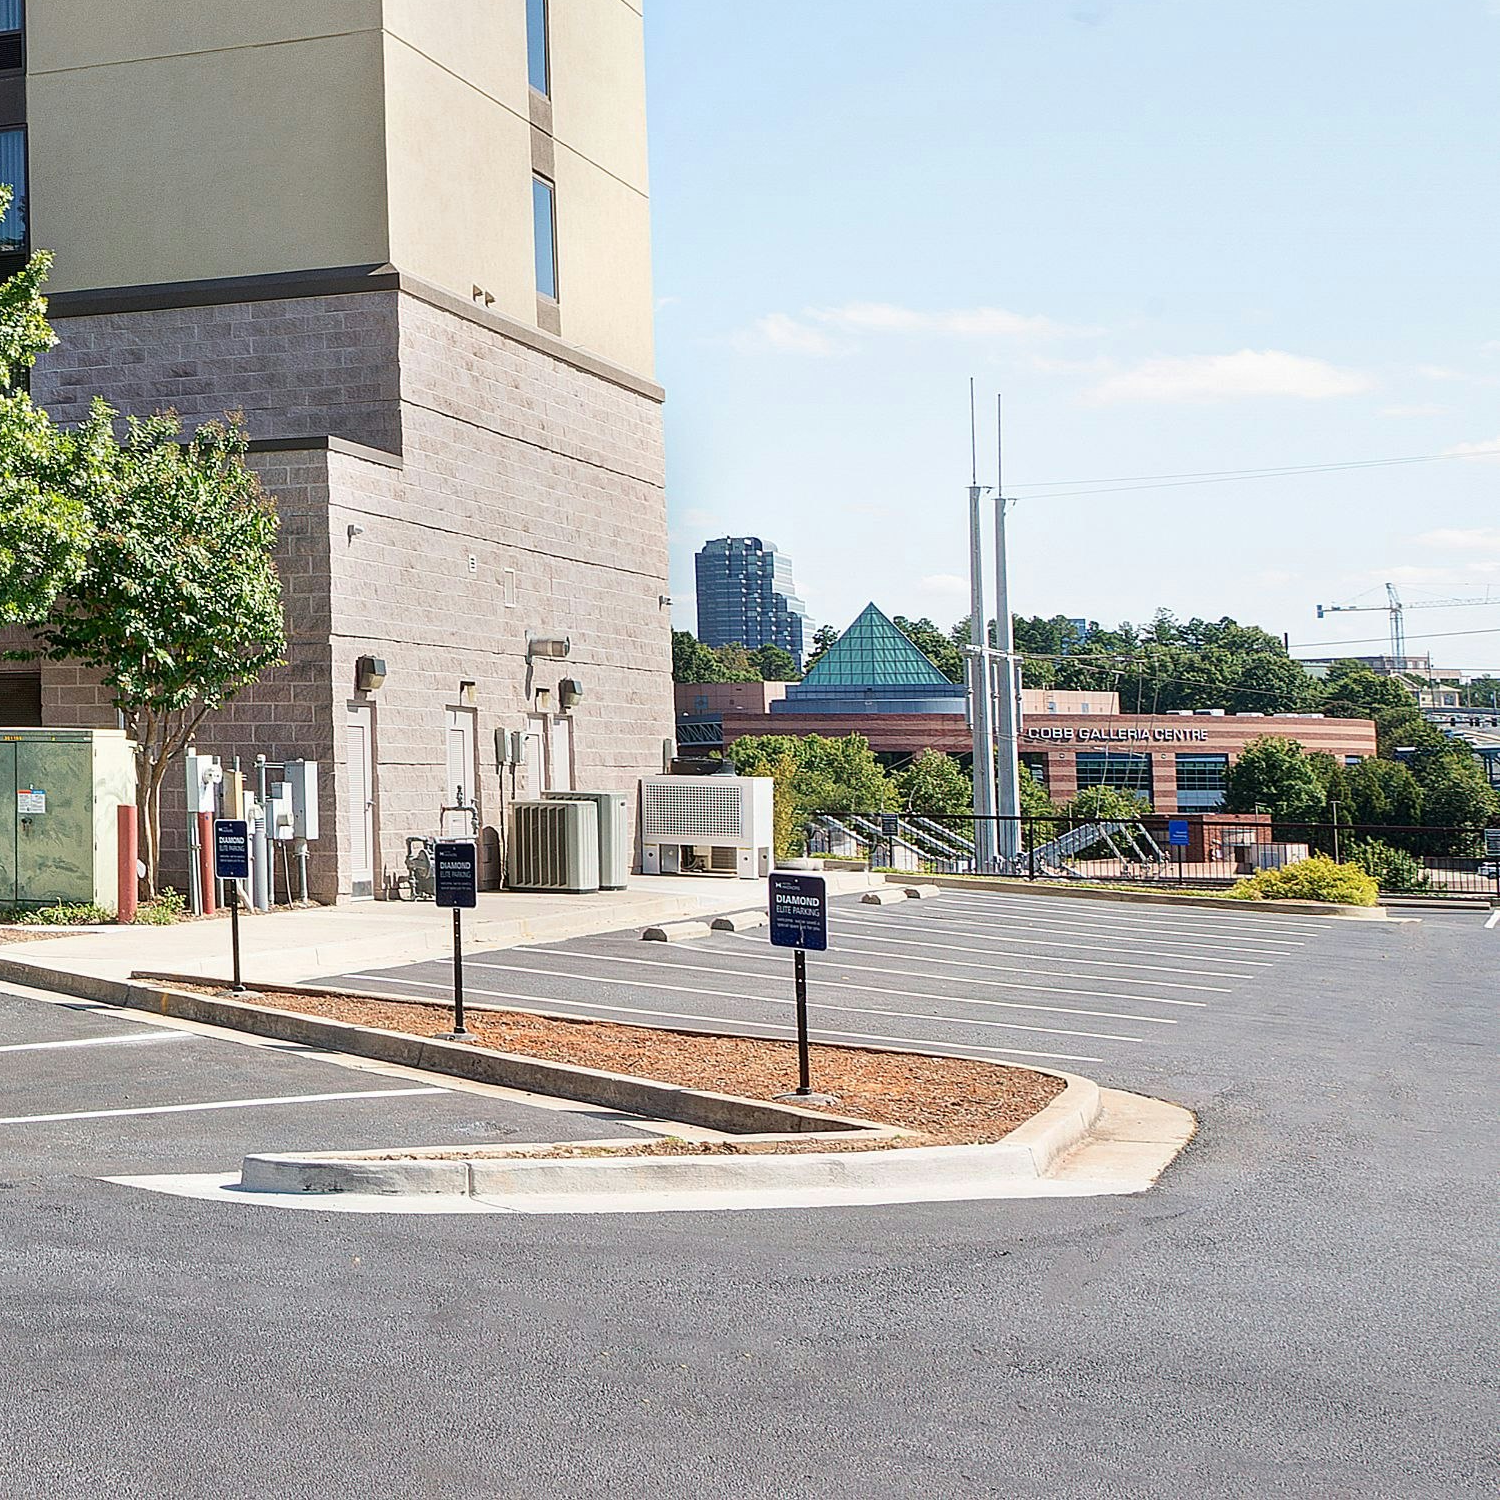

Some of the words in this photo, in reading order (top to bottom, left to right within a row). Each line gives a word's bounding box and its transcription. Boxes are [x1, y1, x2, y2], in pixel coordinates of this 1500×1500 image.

[1028, 727, 1074, 740] COBB
[1078, 728, 1150, 741] GALLERIA
[1153, 728, 1209, 741] CENTRE
[439, 861, 471, 870] DIAMOND
[775, 894, 820, 907] DIAMOND
[776, 904, 792, 915] ELITE
[792, 906, 820, 917] PARKING
